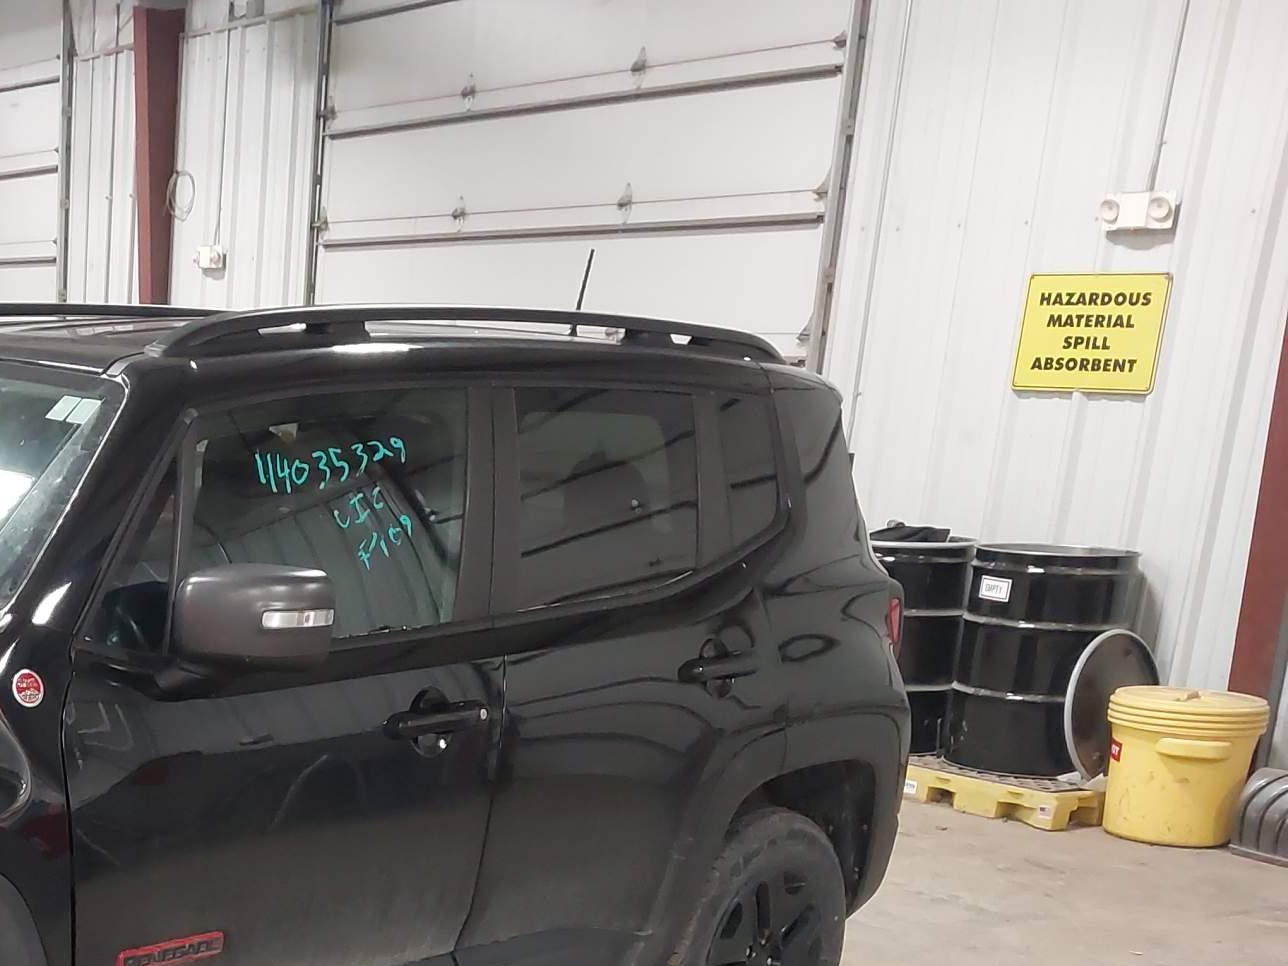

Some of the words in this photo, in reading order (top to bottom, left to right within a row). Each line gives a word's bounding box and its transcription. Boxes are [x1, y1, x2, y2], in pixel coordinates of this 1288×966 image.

[1039, 292, 1153, 307] HAZARDOUS
[1046, 314, 1135, 329] MATERIAL
[1062, 336, 1111, 350] SPILL
[1030, 357, 1138, 373] ABSORBENT
